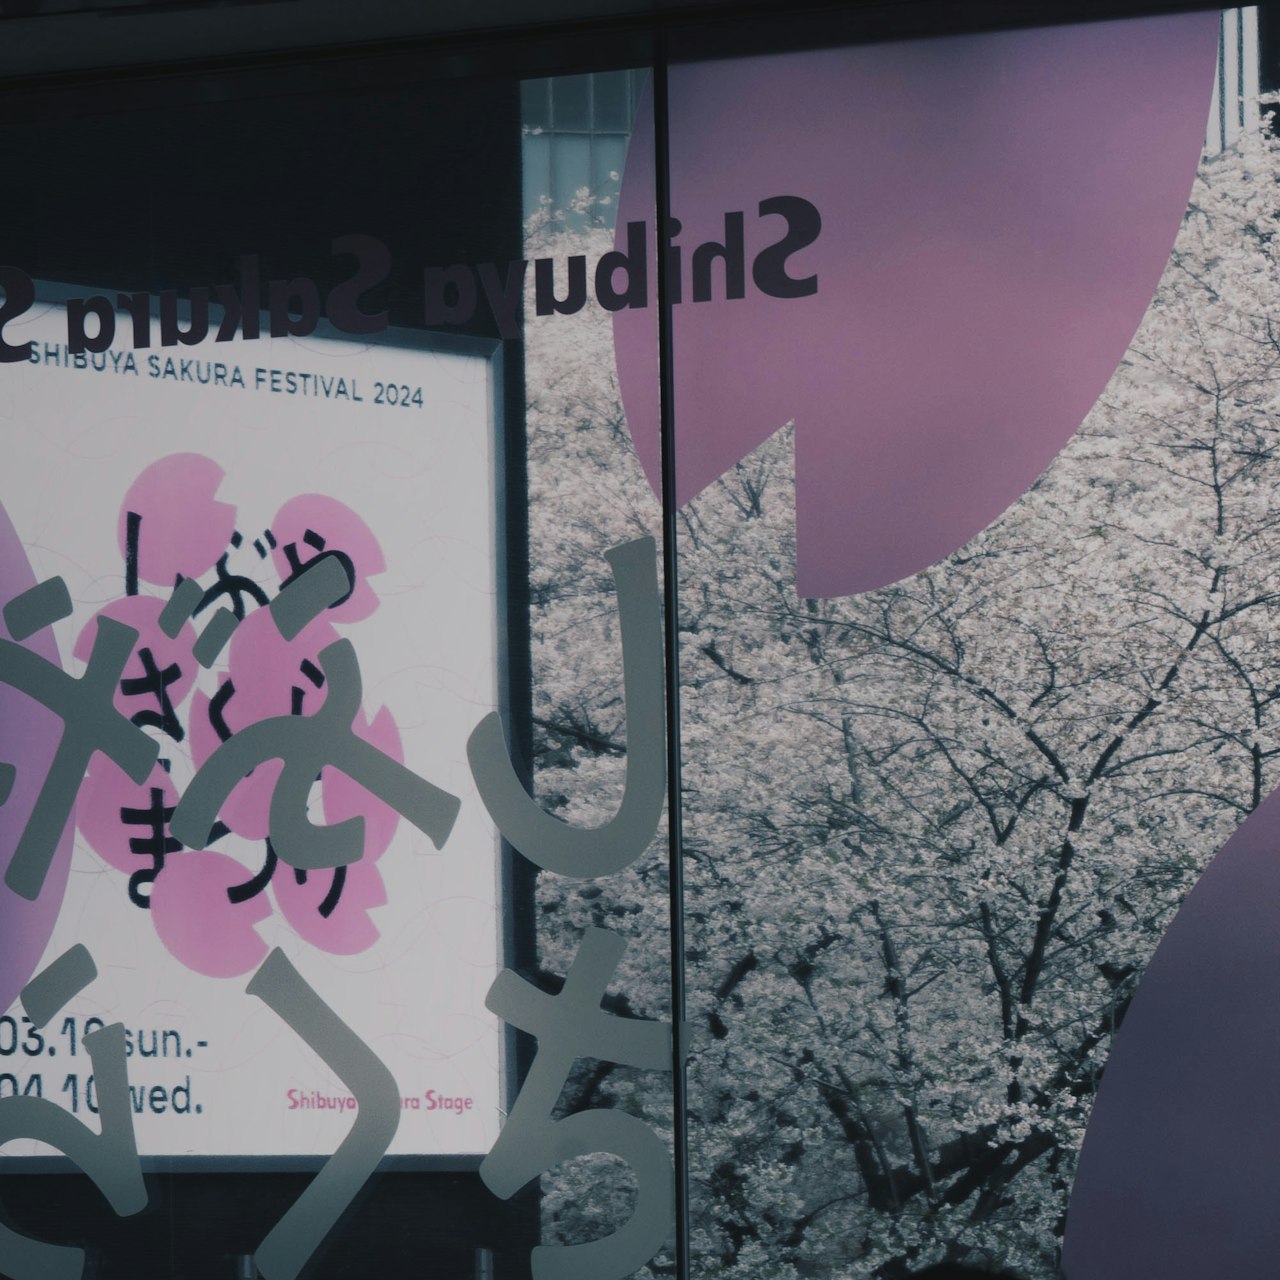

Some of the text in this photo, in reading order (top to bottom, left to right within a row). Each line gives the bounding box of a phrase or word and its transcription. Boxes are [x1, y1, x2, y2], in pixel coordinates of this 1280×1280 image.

[28, 340, 425, 410] SHIBUYA SAKURA FESTIVAL 2024
[425, 1088, 474, 1112] Stage
